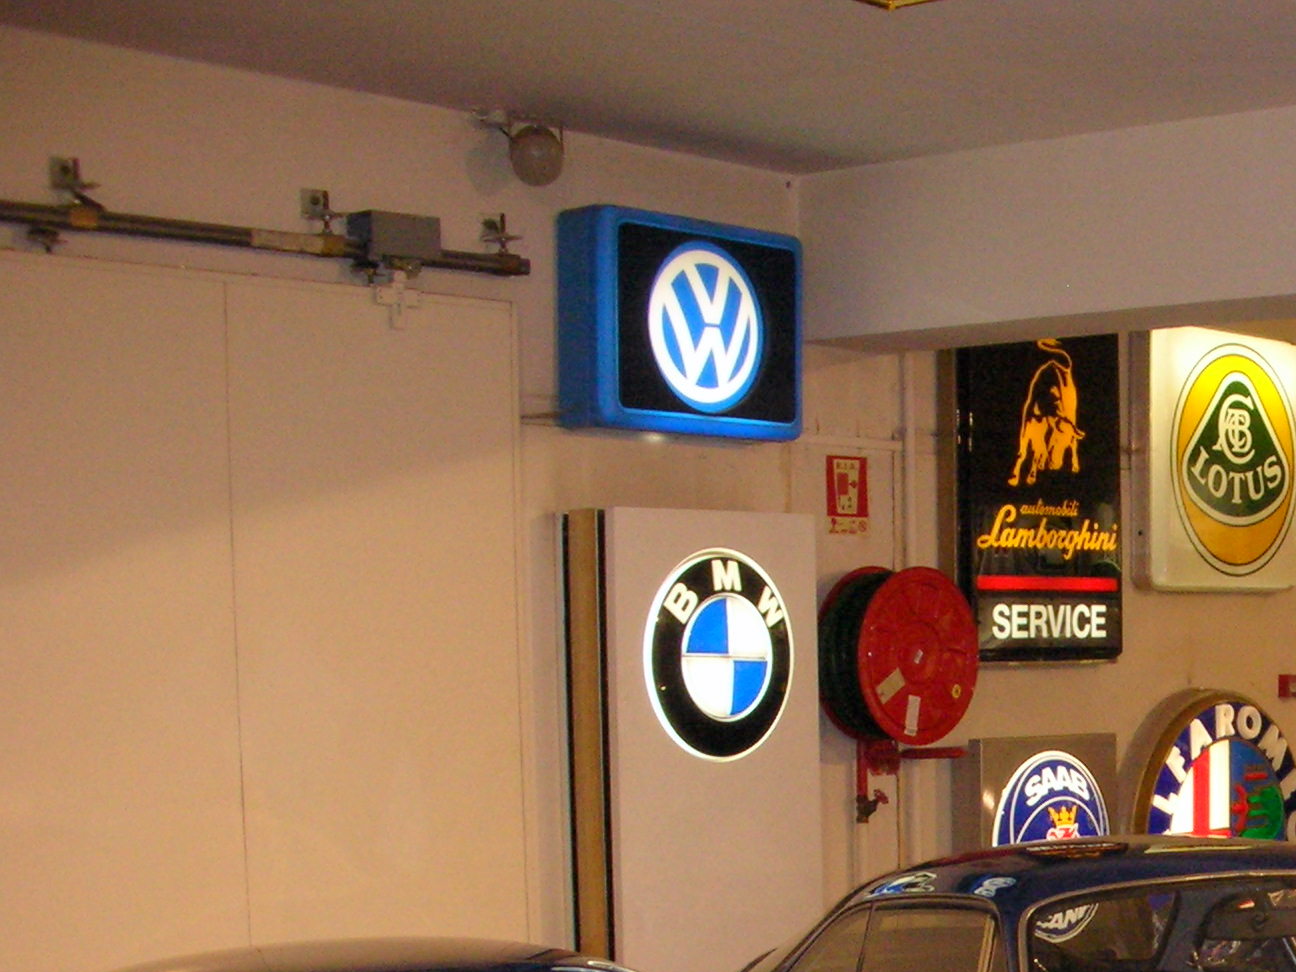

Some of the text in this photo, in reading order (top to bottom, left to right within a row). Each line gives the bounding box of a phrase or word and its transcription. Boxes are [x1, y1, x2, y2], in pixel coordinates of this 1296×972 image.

[1191, 446, 1282, 503] LOTUS
[1020, 498, 1079, 516] automobili
[977, 505, 1118, 560] Lamborghini
[663, 559, 784, 628] BMW
[992, 604, 1107, 639] SERVICE
[1024, 765, 1090, 806] SAAB
